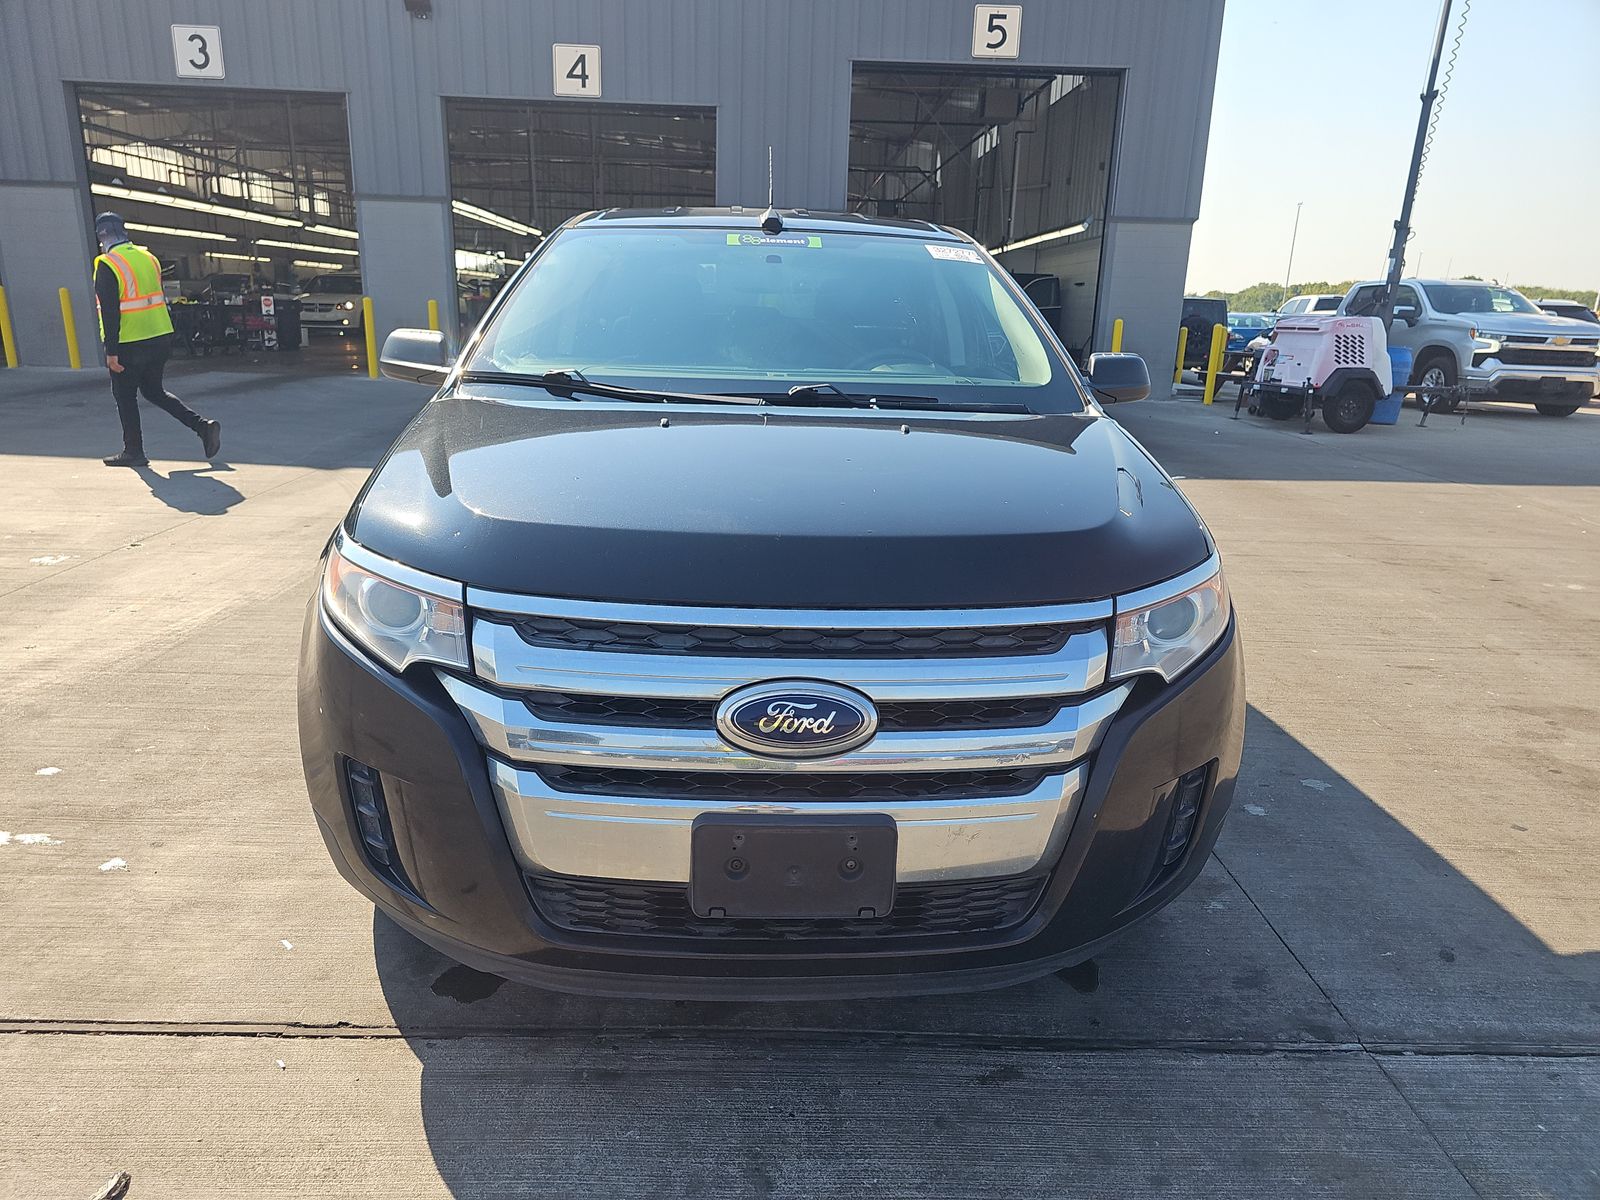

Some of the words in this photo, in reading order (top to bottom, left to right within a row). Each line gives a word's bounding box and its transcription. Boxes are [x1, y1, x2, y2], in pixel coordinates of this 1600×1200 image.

[986, 14, 1007, 49] 5
[188, 34, 210, 70] 3
[566, 54, 589, 88] 4
[760, 237, 805, 245] element
[758, 701, 837, 734] Ford
